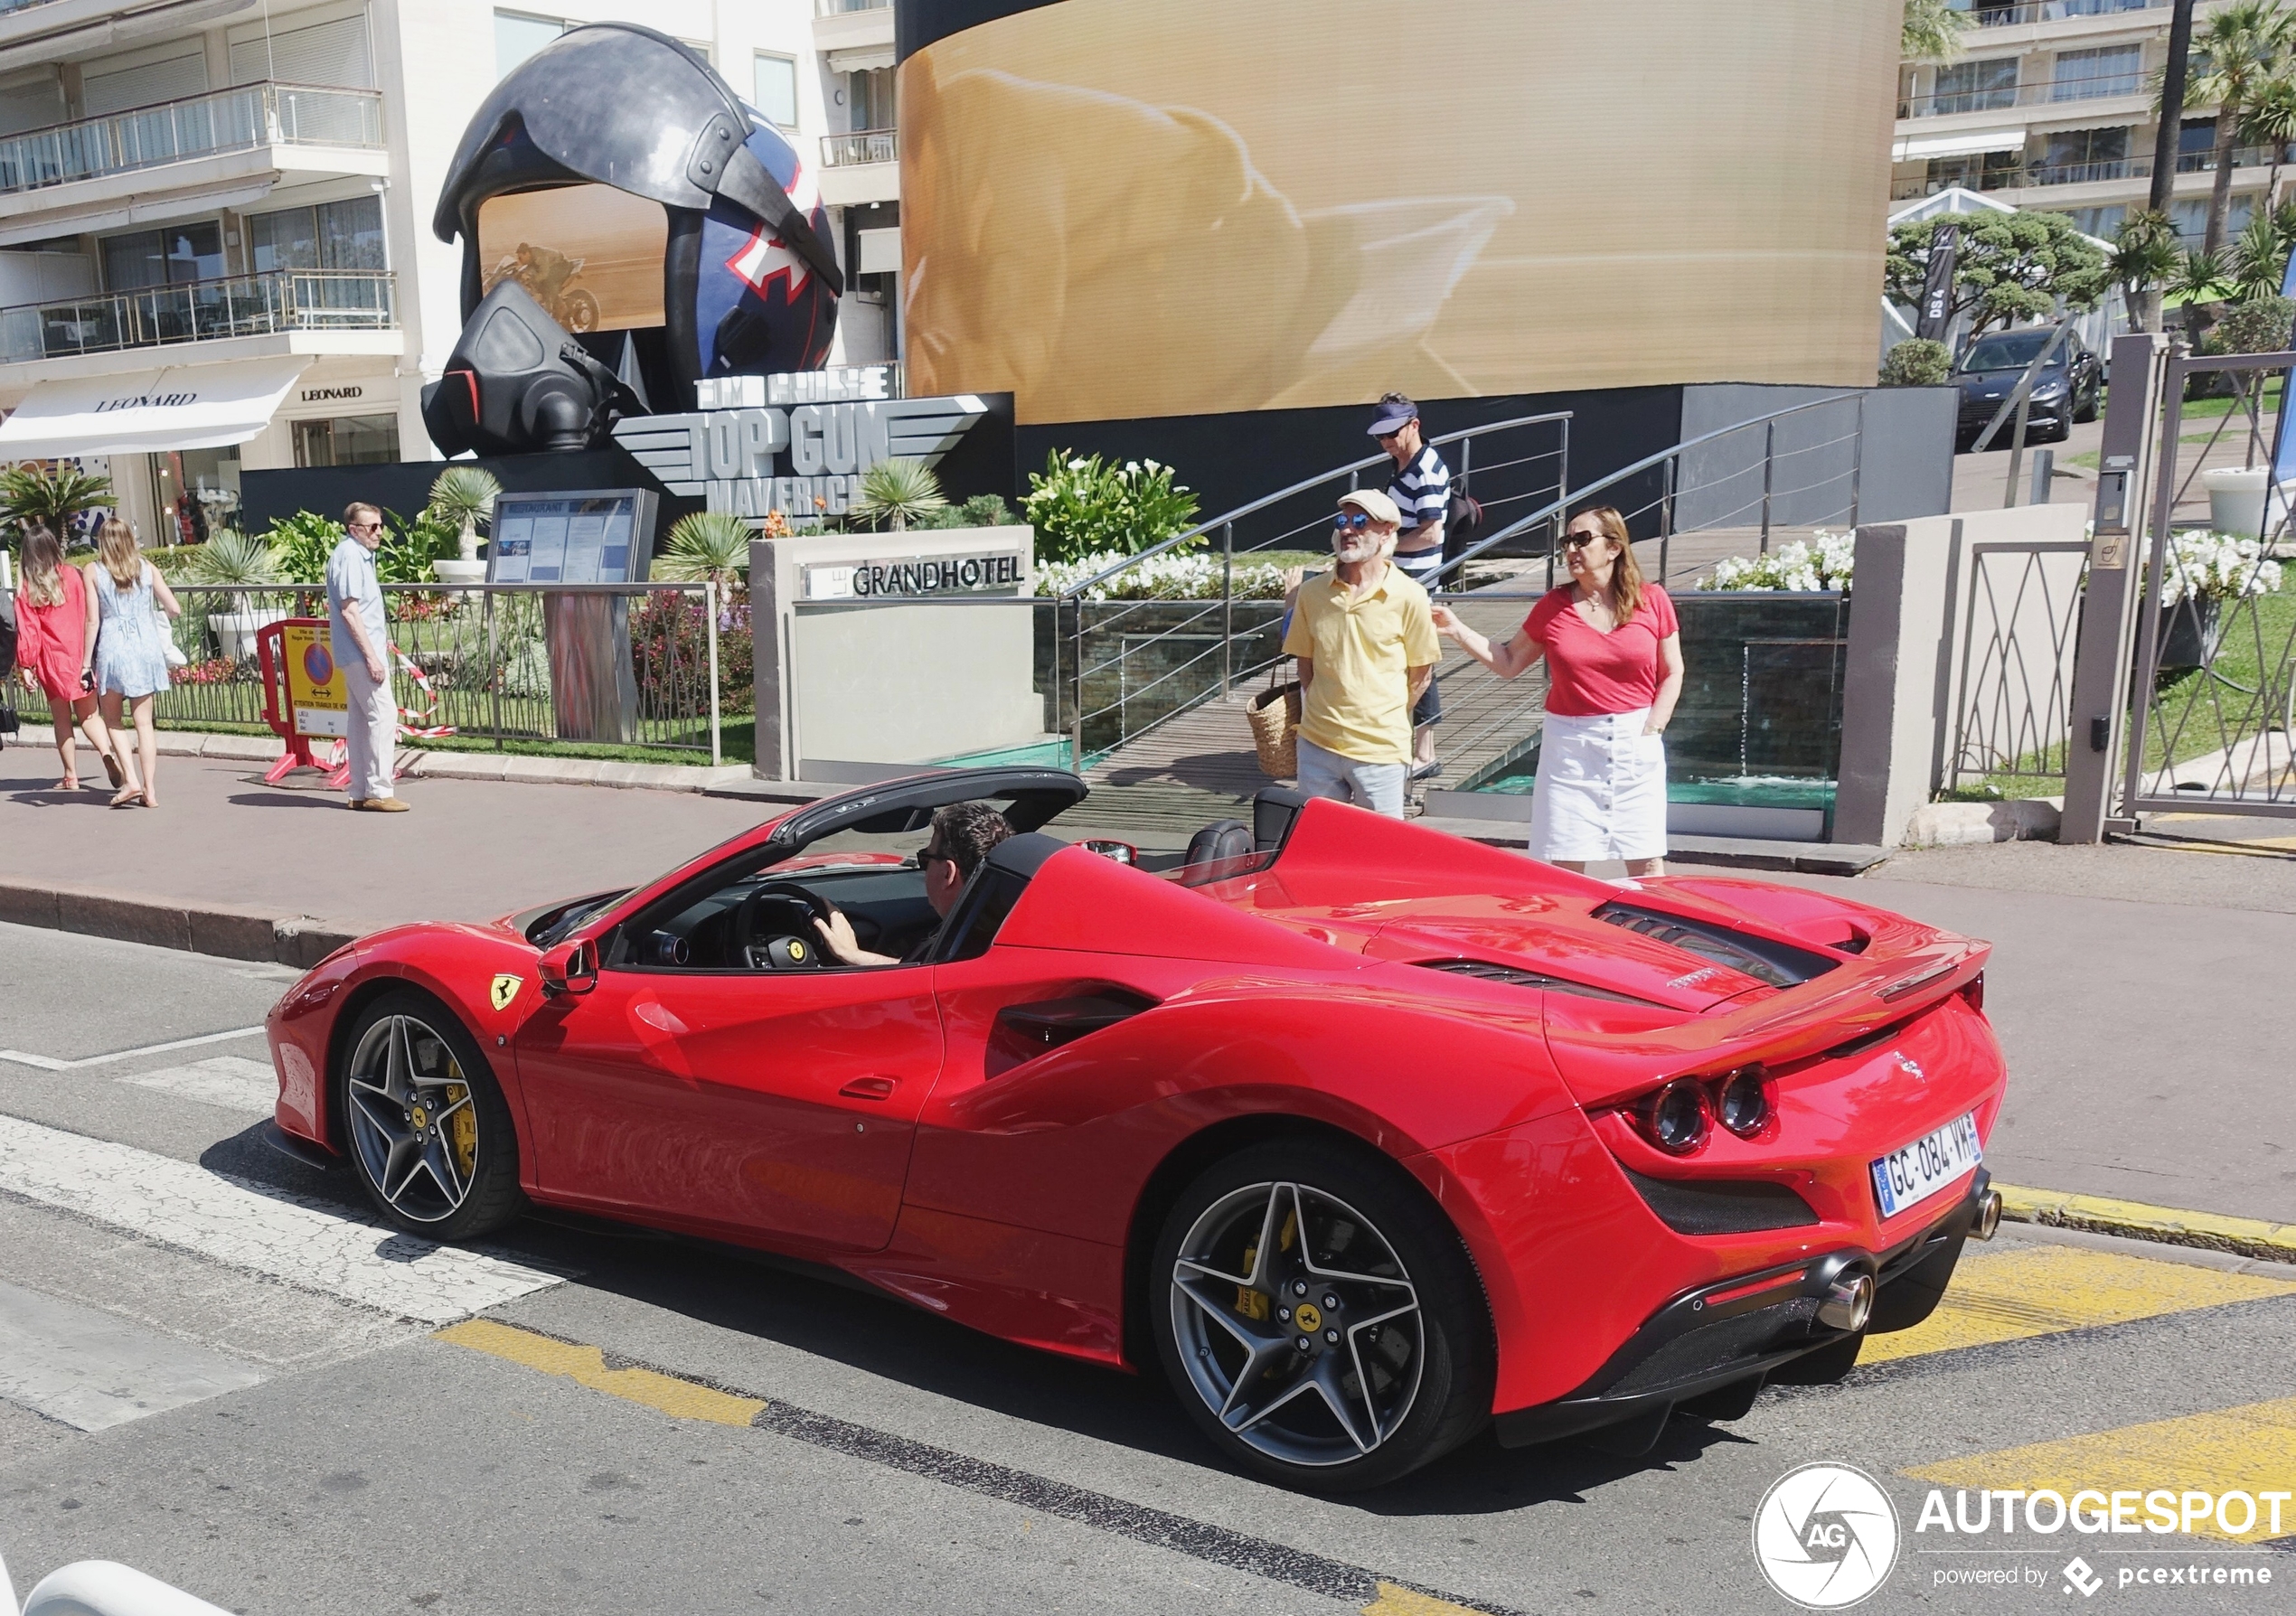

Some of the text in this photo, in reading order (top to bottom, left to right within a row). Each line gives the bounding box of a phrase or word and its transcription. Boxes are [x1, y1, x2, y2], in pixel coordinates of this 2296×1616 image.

[95, 393, 197, 412] LEONARD
[301, 387, 362, 401] LEONARD
[689, 401, 891, 481] TOP GUN
